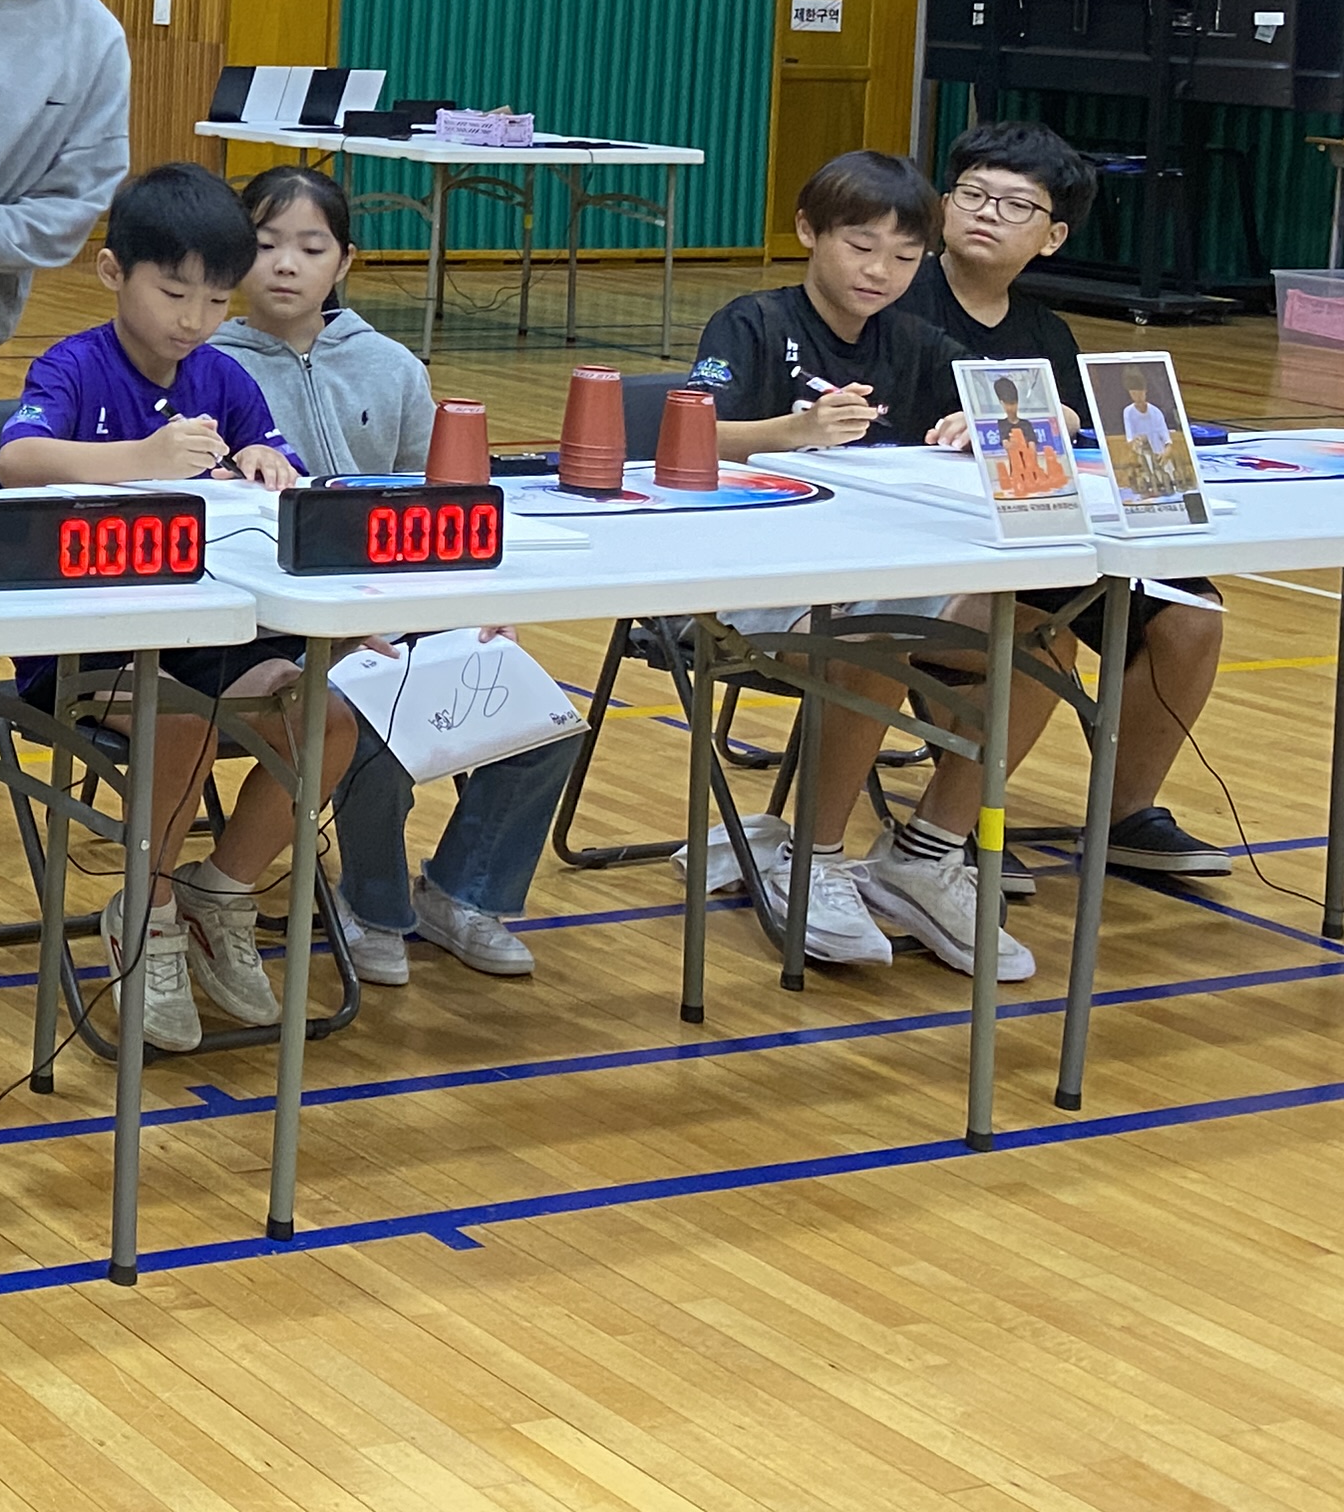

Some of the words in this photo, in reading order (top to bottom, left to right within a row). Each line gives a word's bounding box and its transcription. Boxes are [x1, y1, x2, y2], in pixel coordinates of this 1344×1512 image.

[793, 7, 840, 24] 제한구역
[59, 515, 199, 578] 0.000
[368, 504, 498, 564] 0.000
